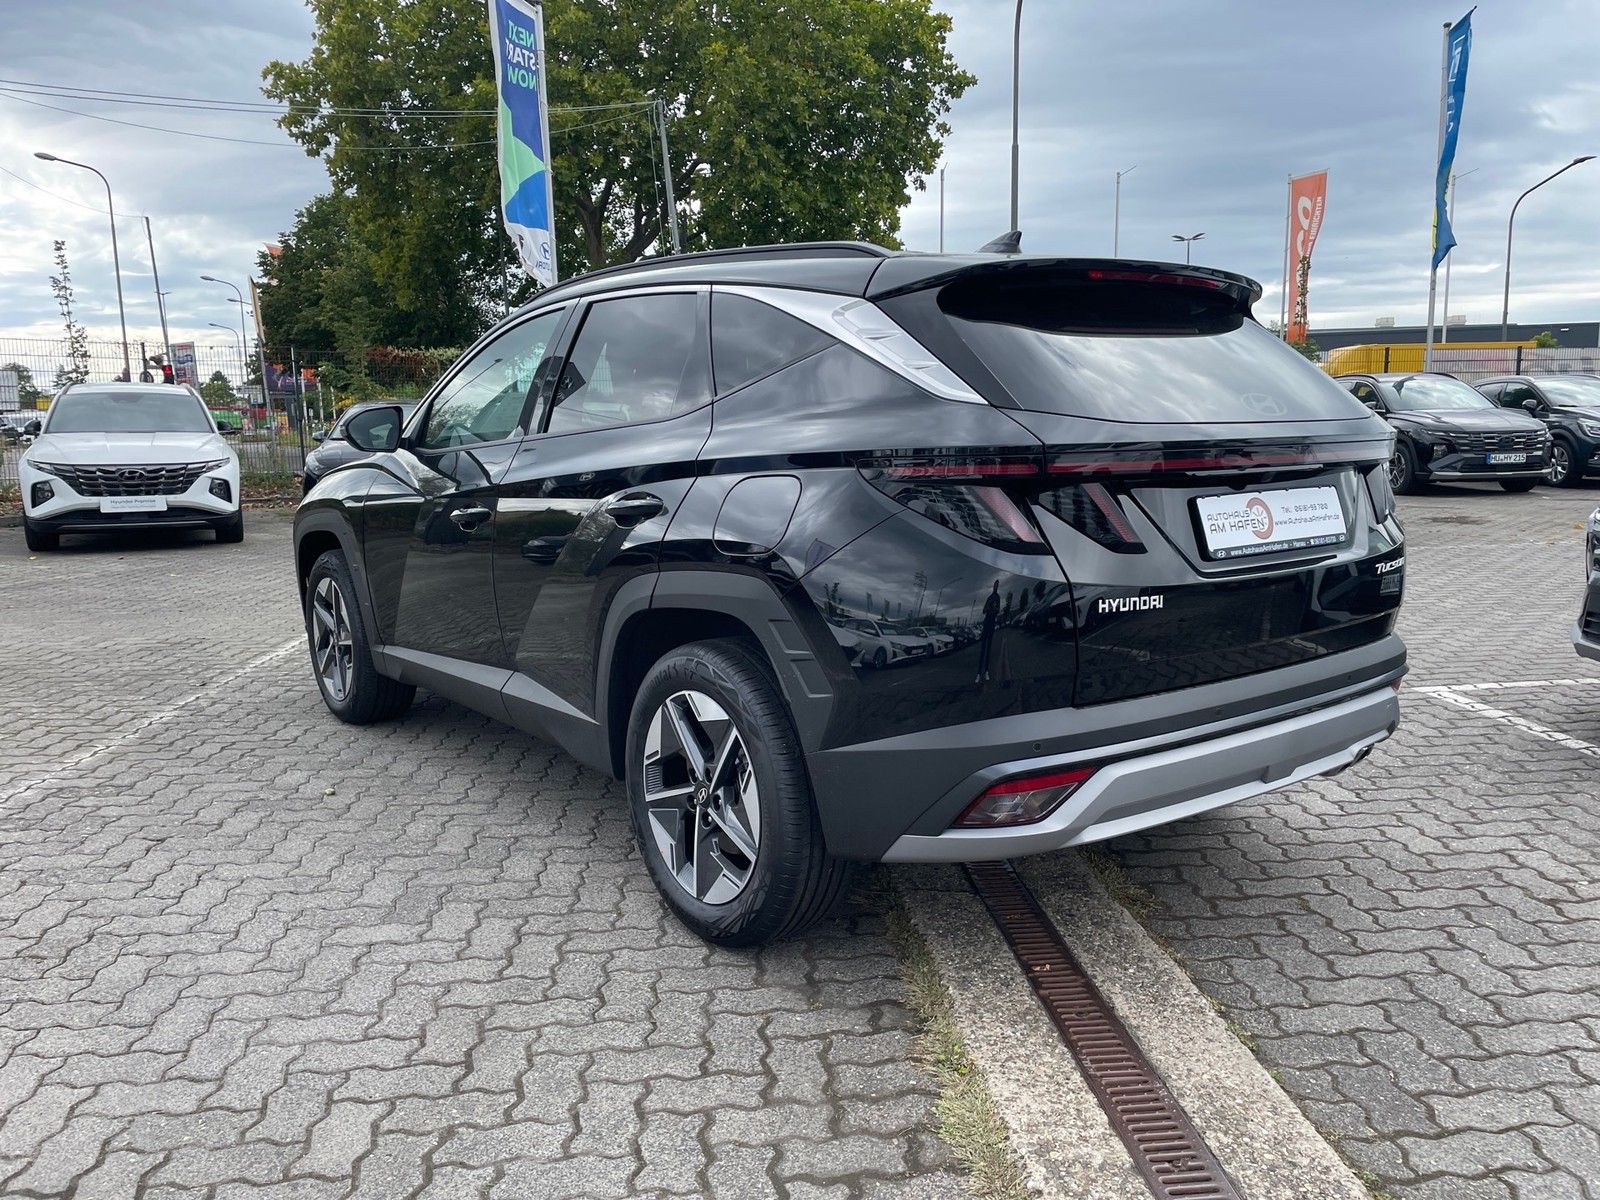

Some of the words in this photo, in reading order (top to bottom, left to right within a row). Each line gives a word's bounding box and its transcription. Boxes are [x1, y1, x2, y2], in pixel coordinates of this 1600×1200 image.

[1513, 454, 1525, 462] 215
[1207, 509, 1250, 522] AUTOHAUS
[1210, 521, 1227, 534] AM
[1229, 518, 1266, 531] HAFEN
[1098, 595, 1163, 613] HYUNDAI
